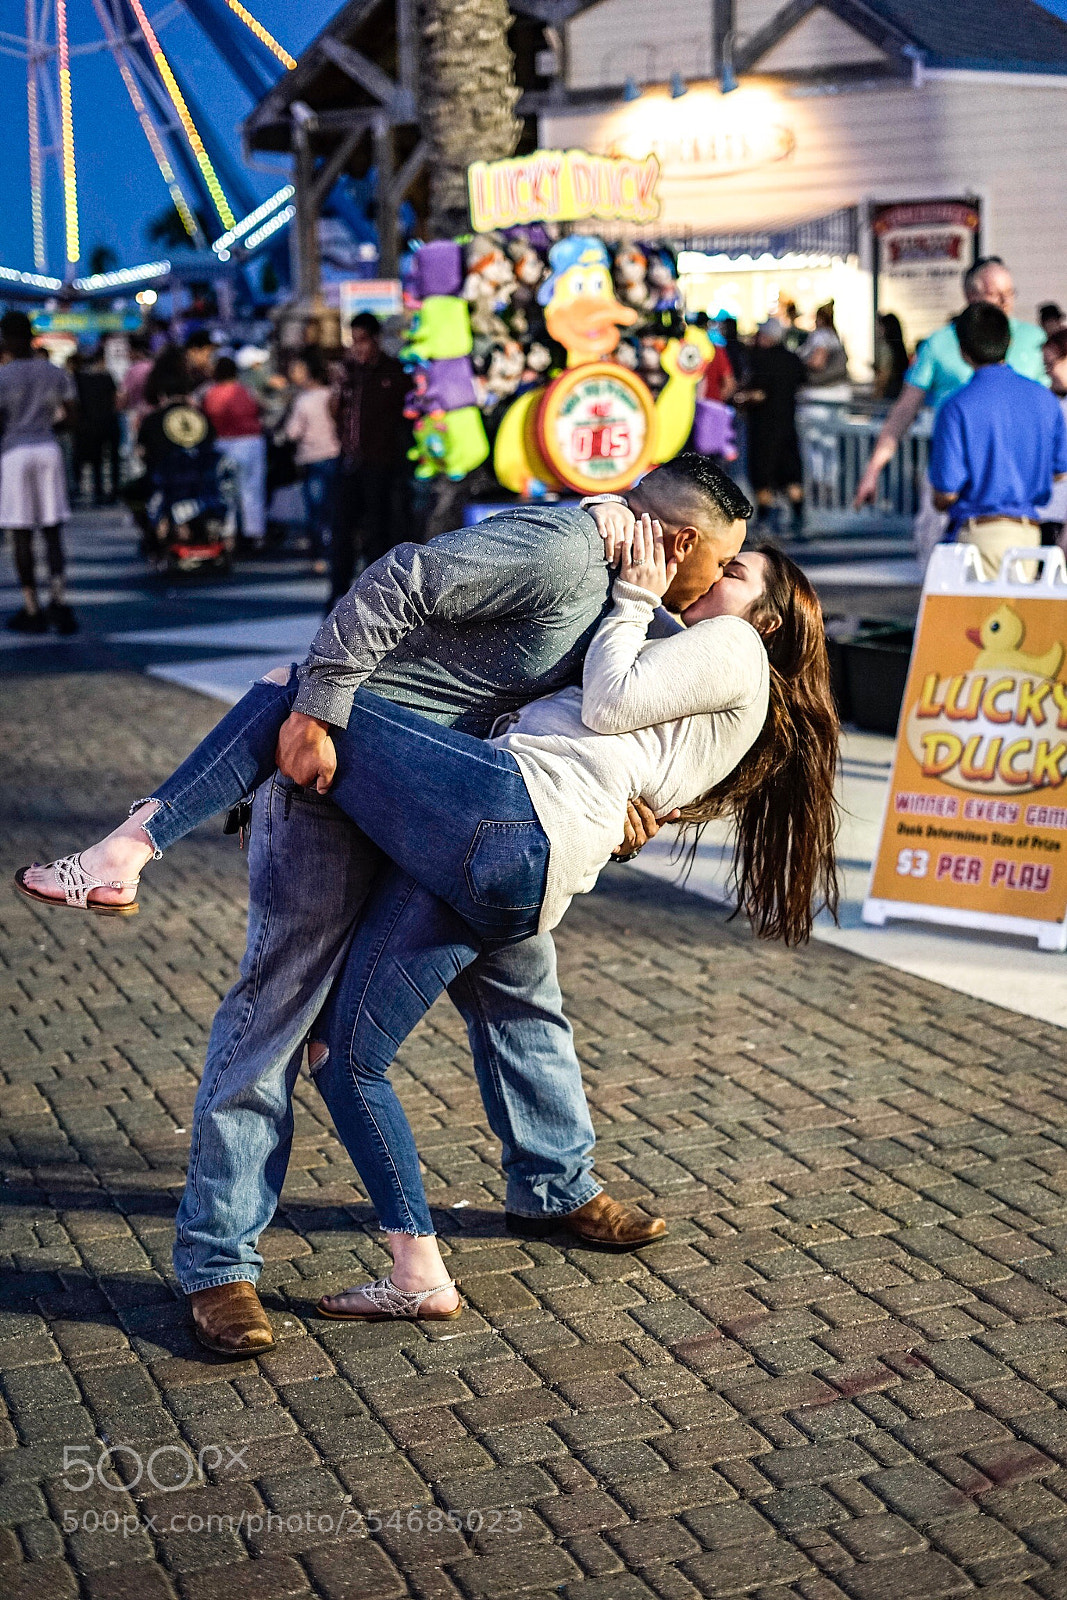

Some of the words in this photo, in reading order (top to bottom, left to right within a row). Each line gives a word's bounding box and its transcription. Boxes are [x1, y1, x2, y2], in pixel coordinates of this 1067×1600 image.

[473, 156, 562, 222] LUCKY
[571, 153, 659, 218] DUCK
[922, 732, 1067, 787] DUCK
[964, 799, 1020, 824] EVERY
[1017, 835, 1030, 848] of
[896, 848, 930, 878] $3
[936, 853, 983, 886] PER
[990, 858, 1053, 894] PLAY
